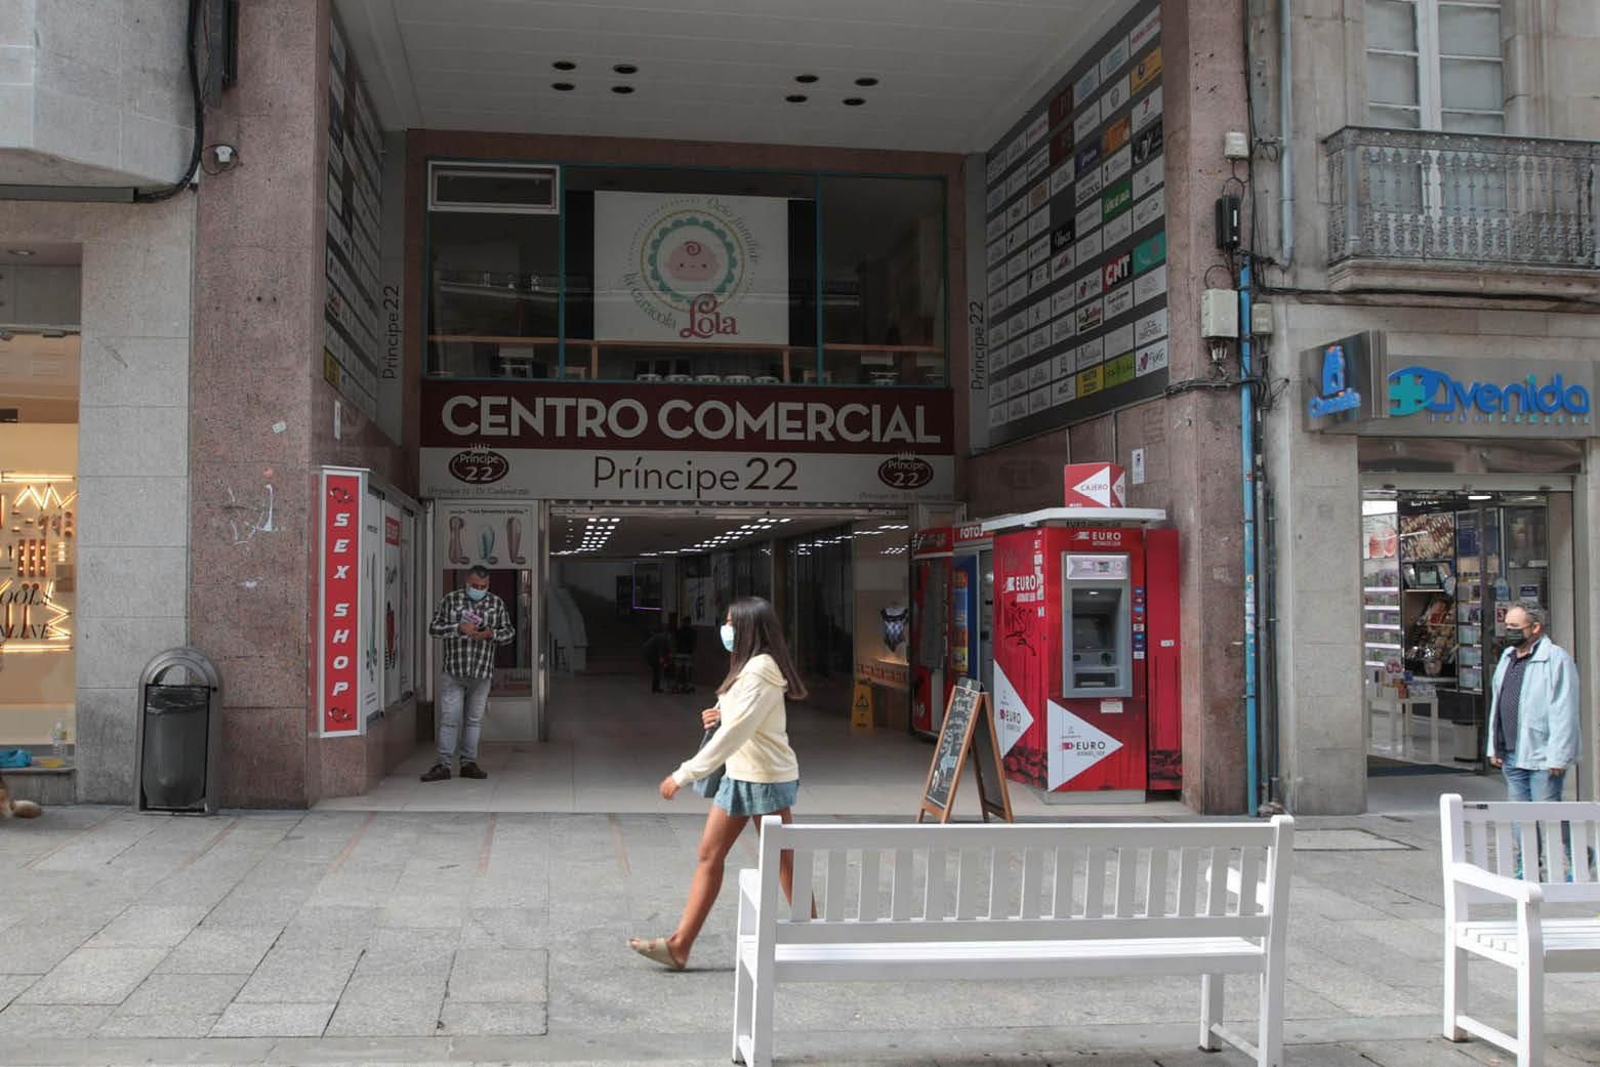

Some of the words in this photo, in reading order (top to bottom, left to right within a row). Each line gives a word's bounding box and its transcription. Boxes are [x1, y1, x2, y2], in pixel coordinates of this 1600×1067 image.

[1105, 254, 1131, 285] CNT
[680, 293, 739, 339] Lola
[1424, 371, 1591, 415] Avenida
[440, 395, 648, 439] CENTRO
[657, 399, 941, 445] COMERCIAL
[465, 466, 493, 480] 22
[745, 457, 799, 491] 22
[893, 472, 919, 486] 22
[332, 512, 350, 580] SEX
[1092, 531, 1122, 541] EURO
[1016, 575, 1036, 591] EURO
[331, 602, 350, 698] SHOP
[1005, 710, 1022, 724] EURO
[1076, 741, 1106, 750] EURO
